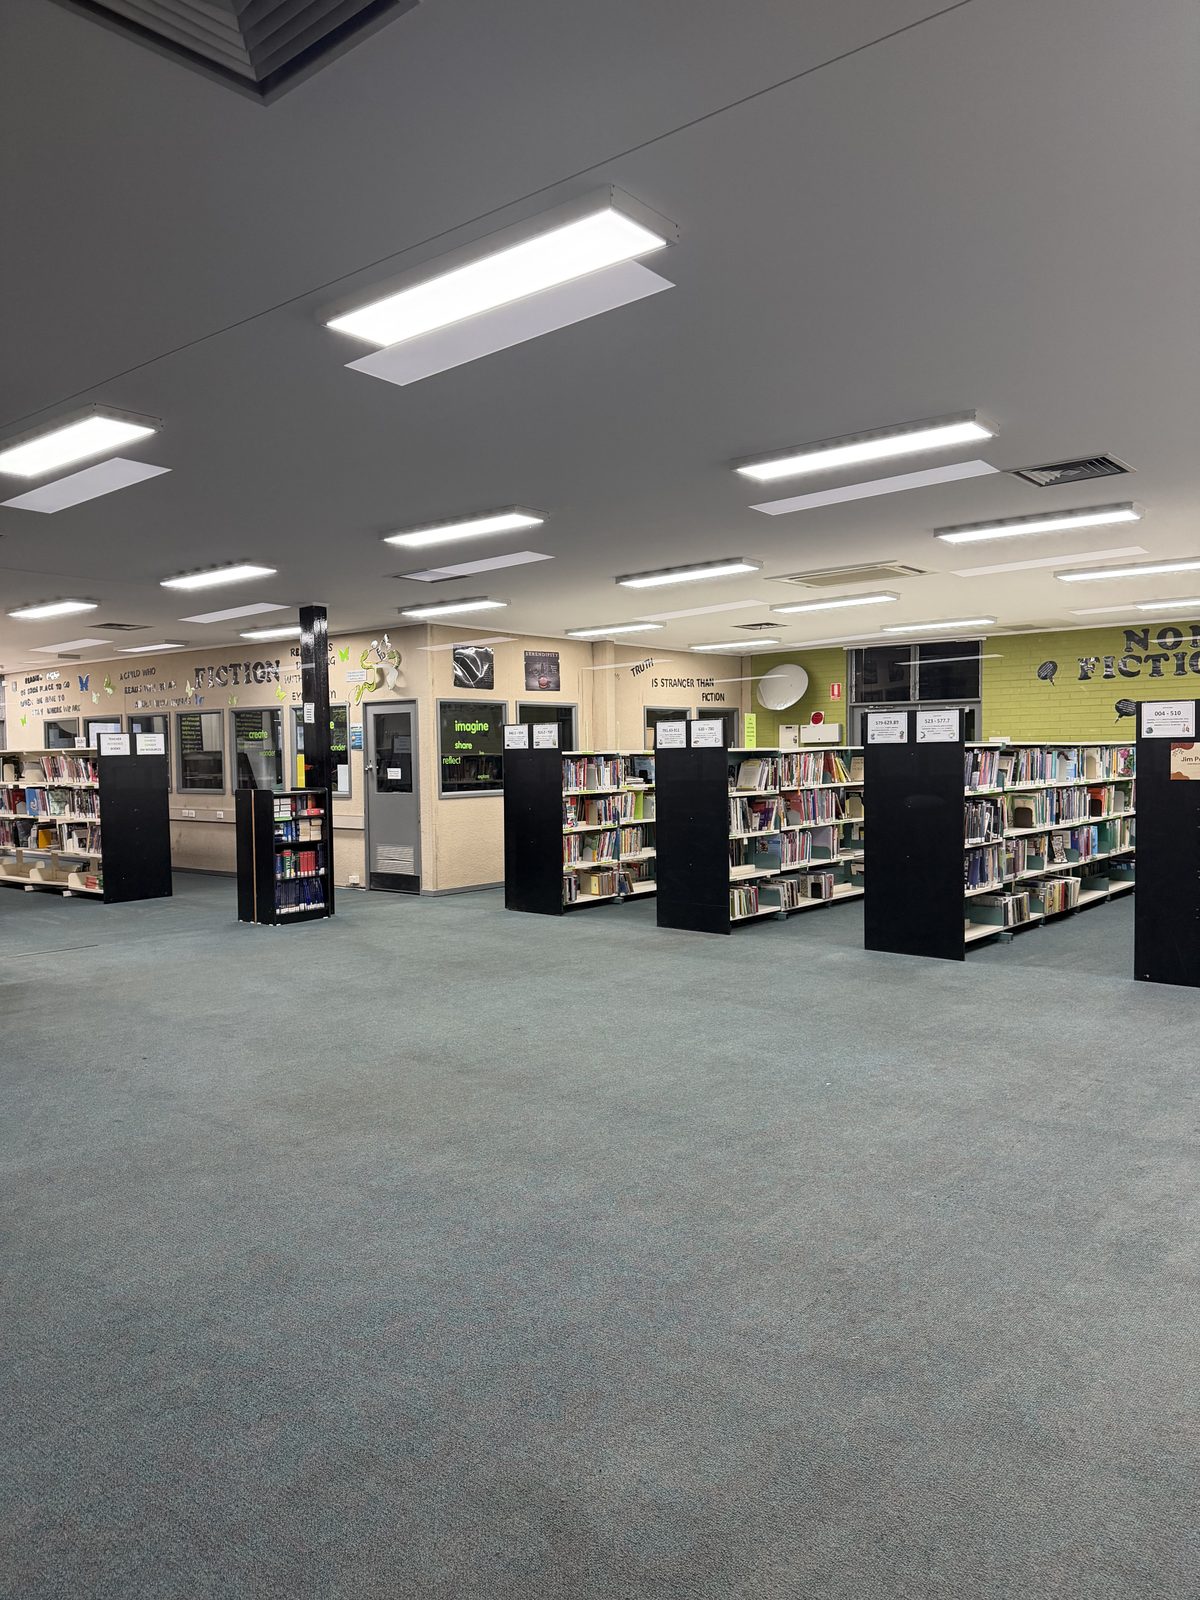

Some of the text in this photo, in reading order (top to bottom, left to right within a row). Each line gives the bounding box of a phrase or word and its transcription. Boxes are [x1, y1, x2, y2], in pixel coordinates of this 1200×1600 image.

[143, 667, 156, 676] WHO
[630, 658, 654, 677] TRUTH
[194, 660, 280, 689] FICTION
[651, 678, 714, 688] IS STRANGER THAN
[701, 692, 725, 702] FICTION
[455, 720, 489, 734] imagine
[249, 730, 268, 739] create
[330, 743, 346, 751] onder
[454, 741, 473, 750] share
[442, 755, 461, 765] reflect
